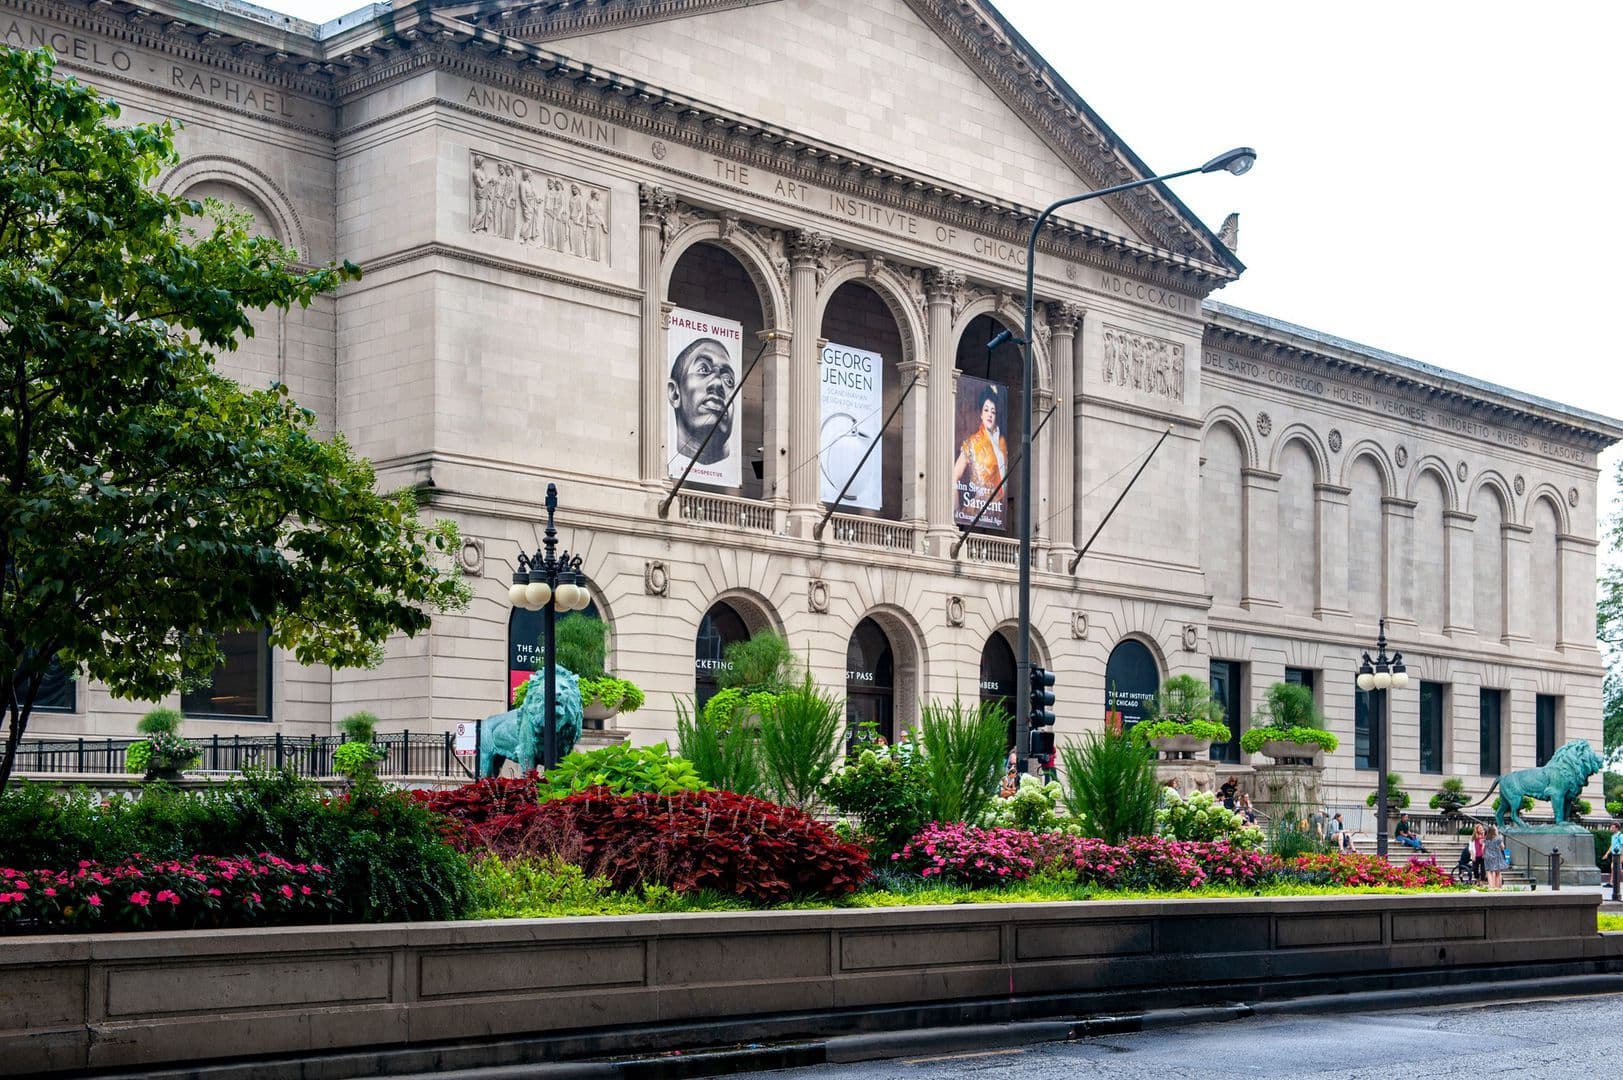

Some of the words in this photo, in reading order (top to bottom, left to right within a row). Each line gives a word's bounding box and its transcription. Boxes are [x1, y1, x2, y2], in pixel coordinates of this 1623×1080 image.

[5, 20, 131, 71] ANGELO
[172, 66, 293, 118] RAPHAEL
[466, 85, 528, 118] ANNO
[539, 105, 616, 145] DOMINI
[713, 159, 749, 186] THE
[774, 178, 808, 202] ART
[829, 193, 918, 235] INSTITVTE
[935, 226, 956, 244] OF
[973, 237, 1037, 266] CHICAG
[1101, 274, 1187, 313] MDCCCXCII
[668, 315, 708, 333] HARLES
[711, 325, 740, 340] WHITE
[823, 347, 872, 373] GEORG
[822, 367, 873, 392] JENSEN
[1205, 351, 1224, 369] DEL
[1228, 358, 1259, 378] SARTO
[1268, 369, 1324, 395] CORREGGIO
[1333, 386, 1371, 406] HOLBEIN
[1382, 399, 1426, 422] VERONESE
[1437, 412, 1489, 438] TINTORETTO
[516, 644, 533, 653] THE
[516, 655, 528, 663] OF
[529, 655, 545, 664] CHI
[695, 659, 734, 671] CKETING
[846, 671, 855, 680] ST
[856, 671, 873, 681] PASS
[1129, 692, 1154, 701] INSTITUTE
